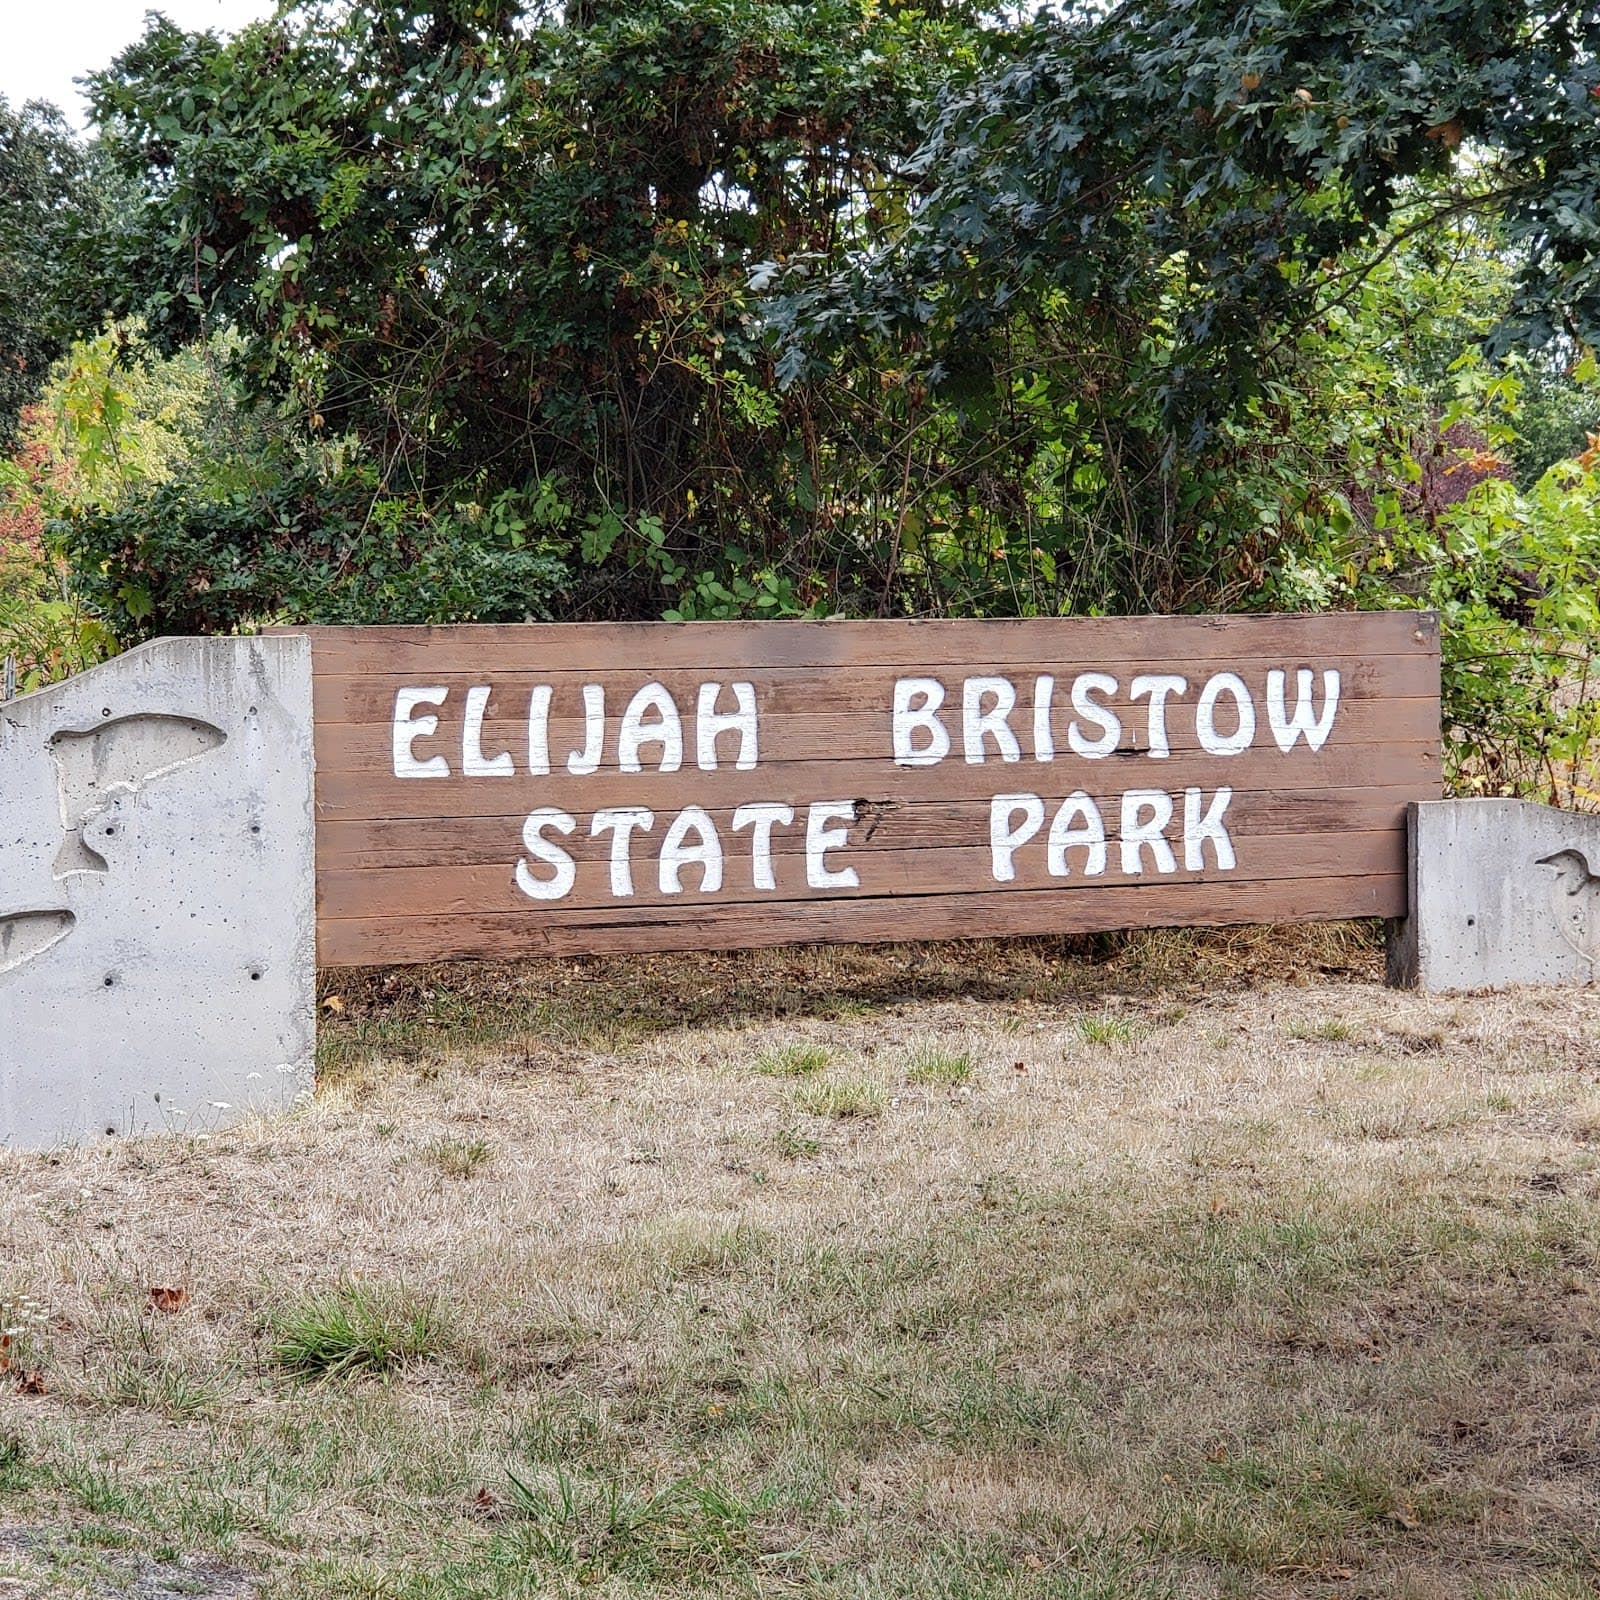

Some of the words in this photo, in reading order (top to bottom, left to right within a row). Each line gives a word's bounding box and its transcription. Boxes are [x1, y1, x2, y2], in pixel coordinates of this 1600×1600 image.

[392, 681, 759, 780] ELIJAH
[892, 668, 1341, 767] BRISTOW
[515, 800, 861, 901] STATE
[989, 786, 1237, 882] PARK
